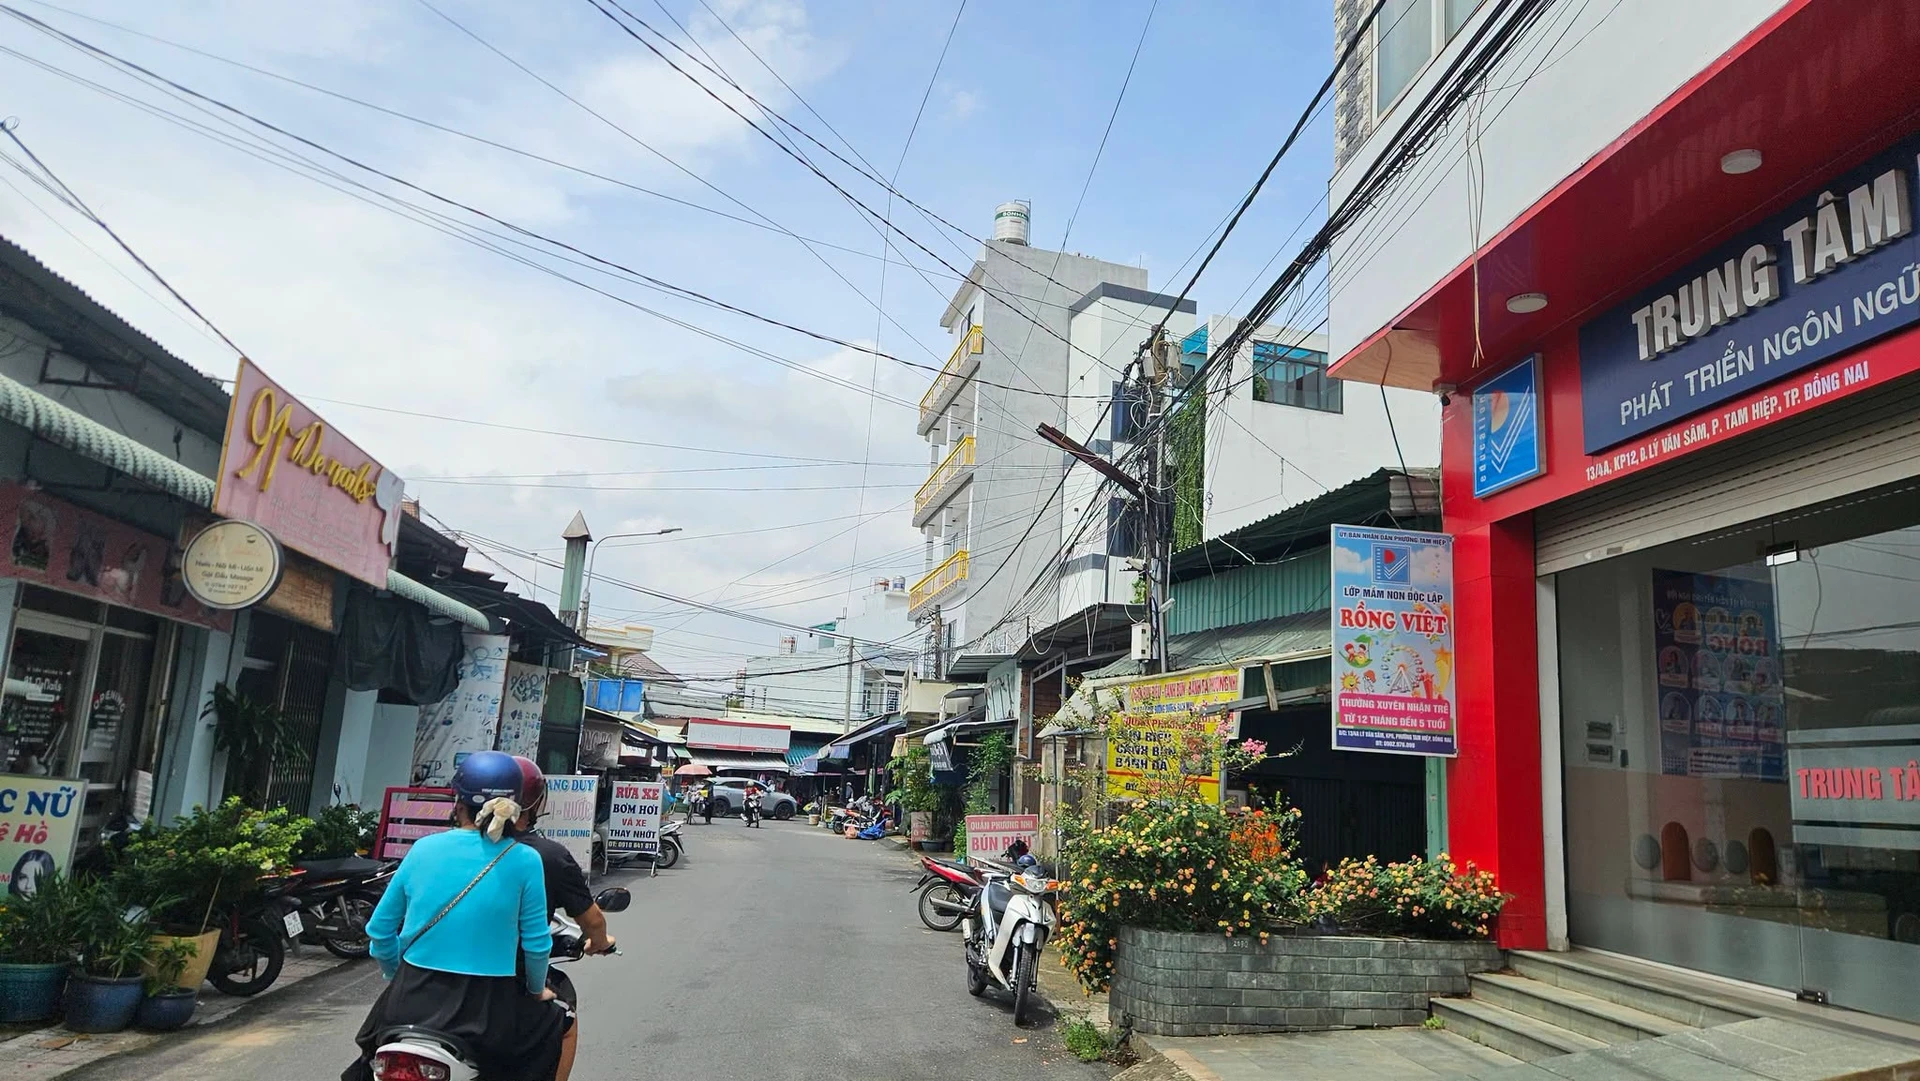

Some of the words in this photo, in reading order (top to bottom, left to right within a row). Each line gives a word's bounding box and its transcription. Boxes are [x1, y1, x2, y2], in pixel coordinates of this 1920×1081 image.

[1632, 243, 1777, 361] TRUNG
[1783, 169, 1910, 285] TÂM
[1620, 380, 1673, 426] PHÁT
[1685, 340, 1754, 397] TRIỂN
[1763, 305, 1843, 365] NGÔN
[1614, 452, 1640, 472] KP12,
[1648, 439, 1660, 460] LÝ
[1661, 431, 1681, 454] VĂN
[1683, 421, 1710, 446] SÂM,
[1711, 420, 1723, 436] P.
[1724, 409, 1749, 431] TAM
[1751, 395, 1782, 423] HIỆP,
[1783, 387, 1801, 408] TP.
[1803, 373, 1840, 398] ĐỒNG
[1843, 361, 1870, 386] NAI
[1478, 395, 1487, 483] education
[1344, 587, 1360, 597] LỚP
[1387, 590, 1405, 600] NON
[1407, 587, 1425, 603] ĐỘC
[1427, 593, 1443, 605] LẬP
[1340, 601, 1396, 630] RỒNG
[1401, 609, 1447, 638] VIỆT
[1340, 697, 1375, 709] THƯỜNG
[1376, 699, 1406, 711] XUYÊN
[1406, 702, 1431, 714] NHẬN
[1433, 702, 1449, 715] TRẺ
[1344, 712, 1356, 723] TỪ
[1357, 715, 1368, 724] 12
[1369, 715, 1398, 726] THÁNG
[1399, 715, 1418, 727] ĐẾN
[1419, 719, 1425, 728] 5
[1426, 718, 1446, 730] TUỔI
[571, 779, 595, 791] DUY
[616, 783, 639, 800] RỬA
[642, 788, 660, 800] XE
[1796, 766, 1883, 800] TRUNG
[24, 785, 78, 818] NỮ
[612, 804, 636, 814] BƠM
[639, 805, 659, 816] HƠI
[14, 820, 48, 844] Hồ
[636, 819, 647, 828] XE
[1020, 820, 1033, 829] NHI
[557, 829, 569, 837] GIA
[570, 829, 590, 839] DỤNG
[610, 829, 631, 839] THAY
[633, 830, 657, 840] NHỚT
[971, 834, 998, 851] BÚN
